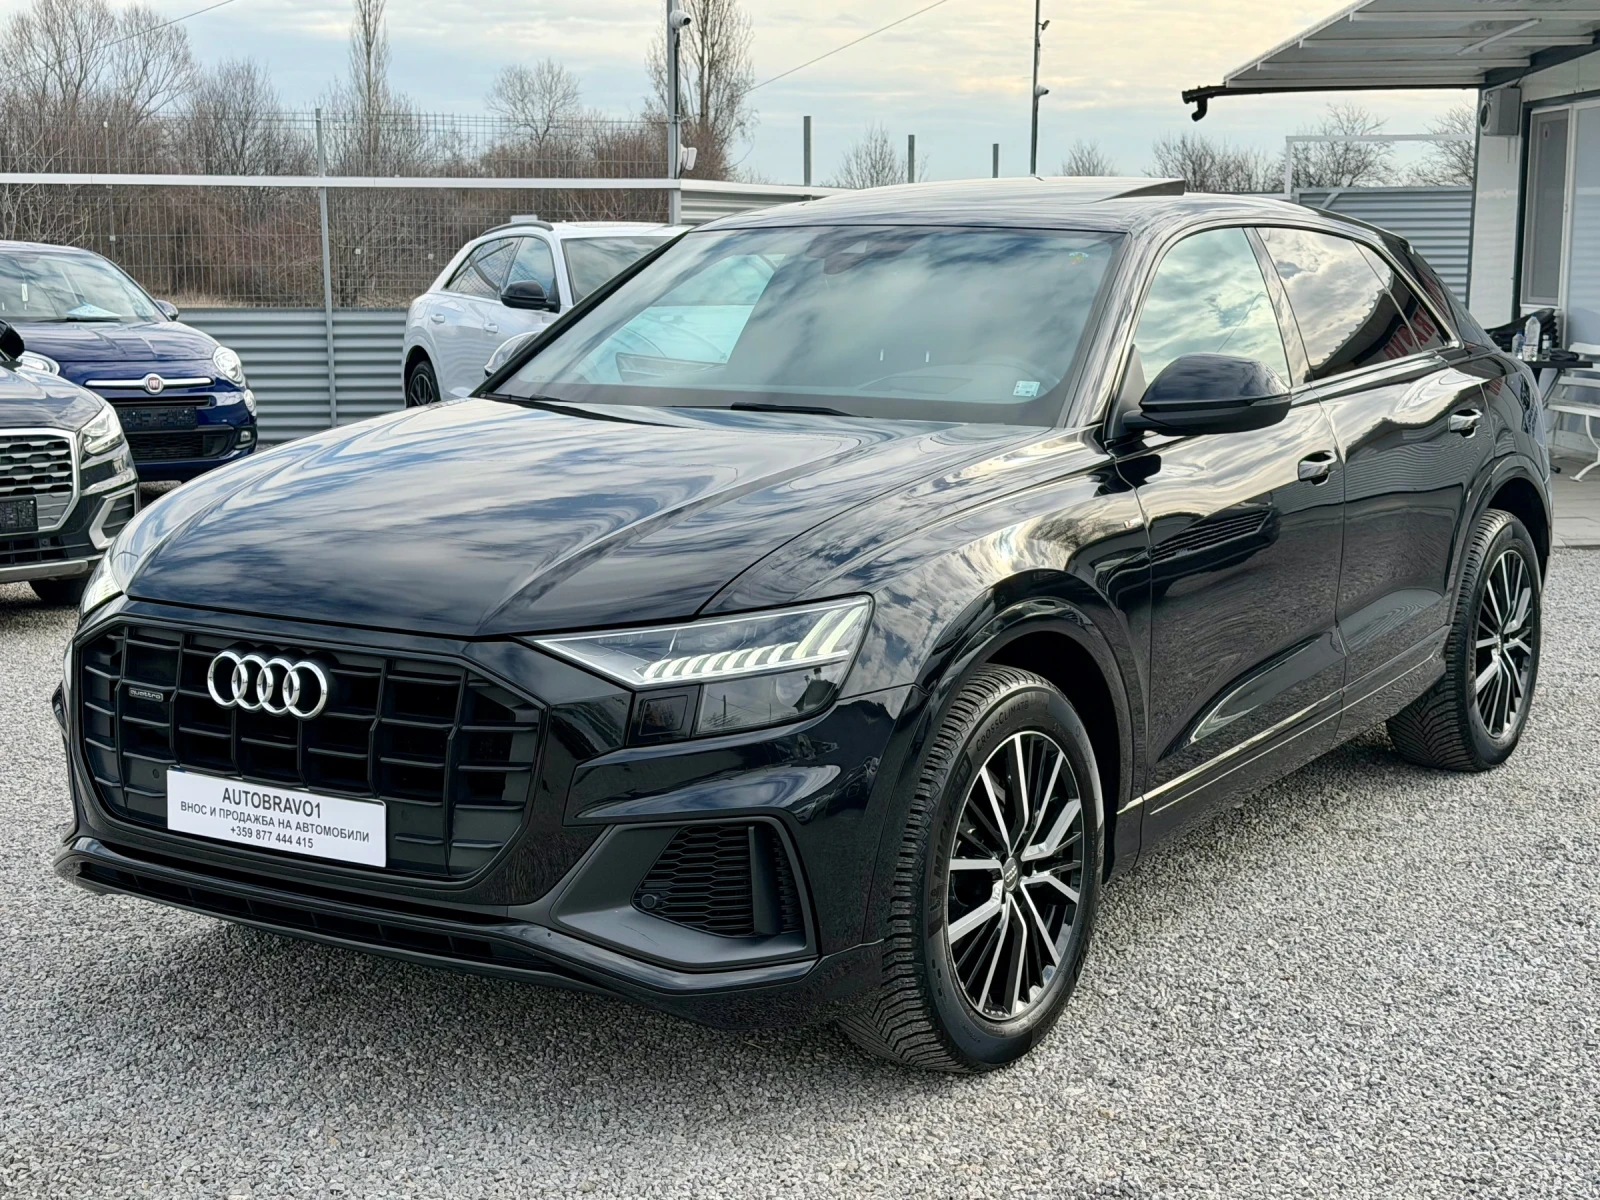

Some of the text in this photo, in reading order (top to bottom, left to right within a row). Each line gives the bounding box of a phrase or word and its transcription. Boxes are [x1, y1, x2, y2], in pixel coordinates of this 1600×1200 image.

[130, 690, 161, 700] quattro
[222, 787, 321, 819] AUTOBRAVO1
[180, 801, 370, 843] ВНОС И ПРОДАЖБА НА АВТОМОБИЛИ
[230, 826, 314, 849] +359 877 444 415
